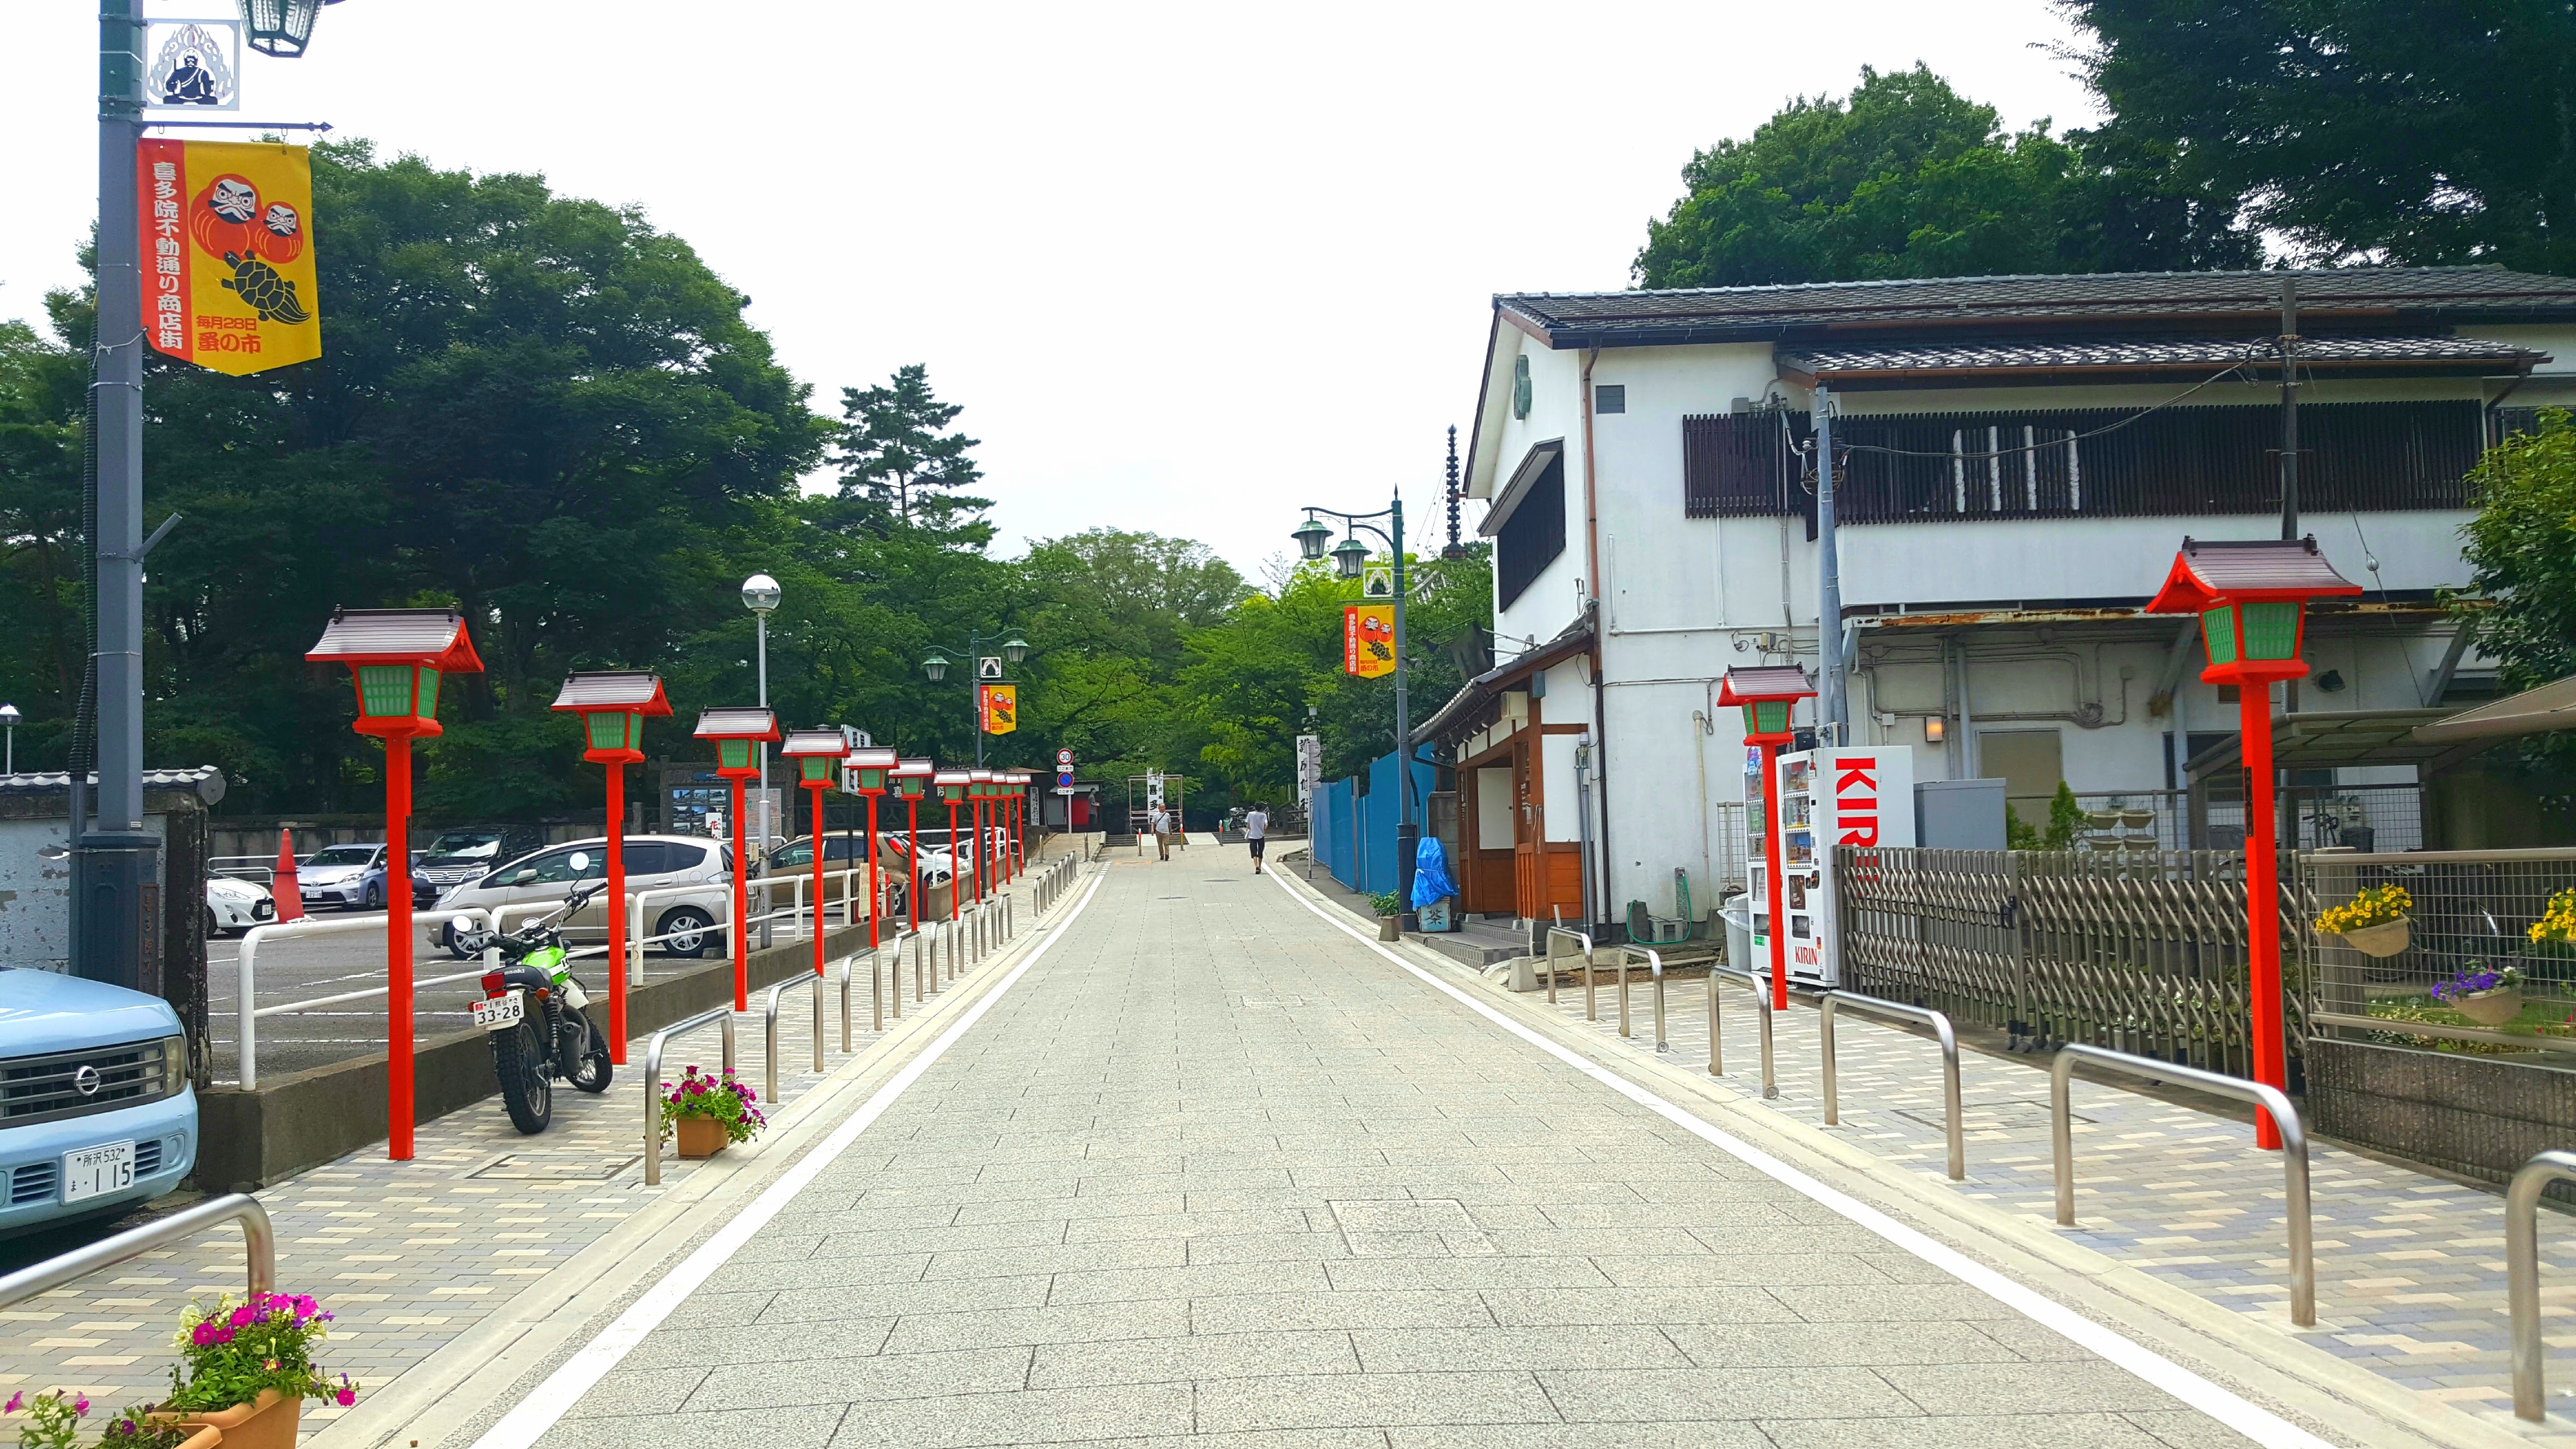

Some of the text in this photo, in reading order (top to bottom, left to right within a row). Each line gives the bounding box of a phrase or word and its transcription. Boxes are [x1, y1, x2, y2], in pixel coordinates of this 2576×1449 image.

[152, 162, 184, 350] 喜多院不動通り商店街
[196, 315, 258, 331] 毎月28日
[197, 332, 262, 354] 蚤の市
[1794, 946, 1818, 966] KIRIN
[478, 1005, 521, 1024] 33-28
